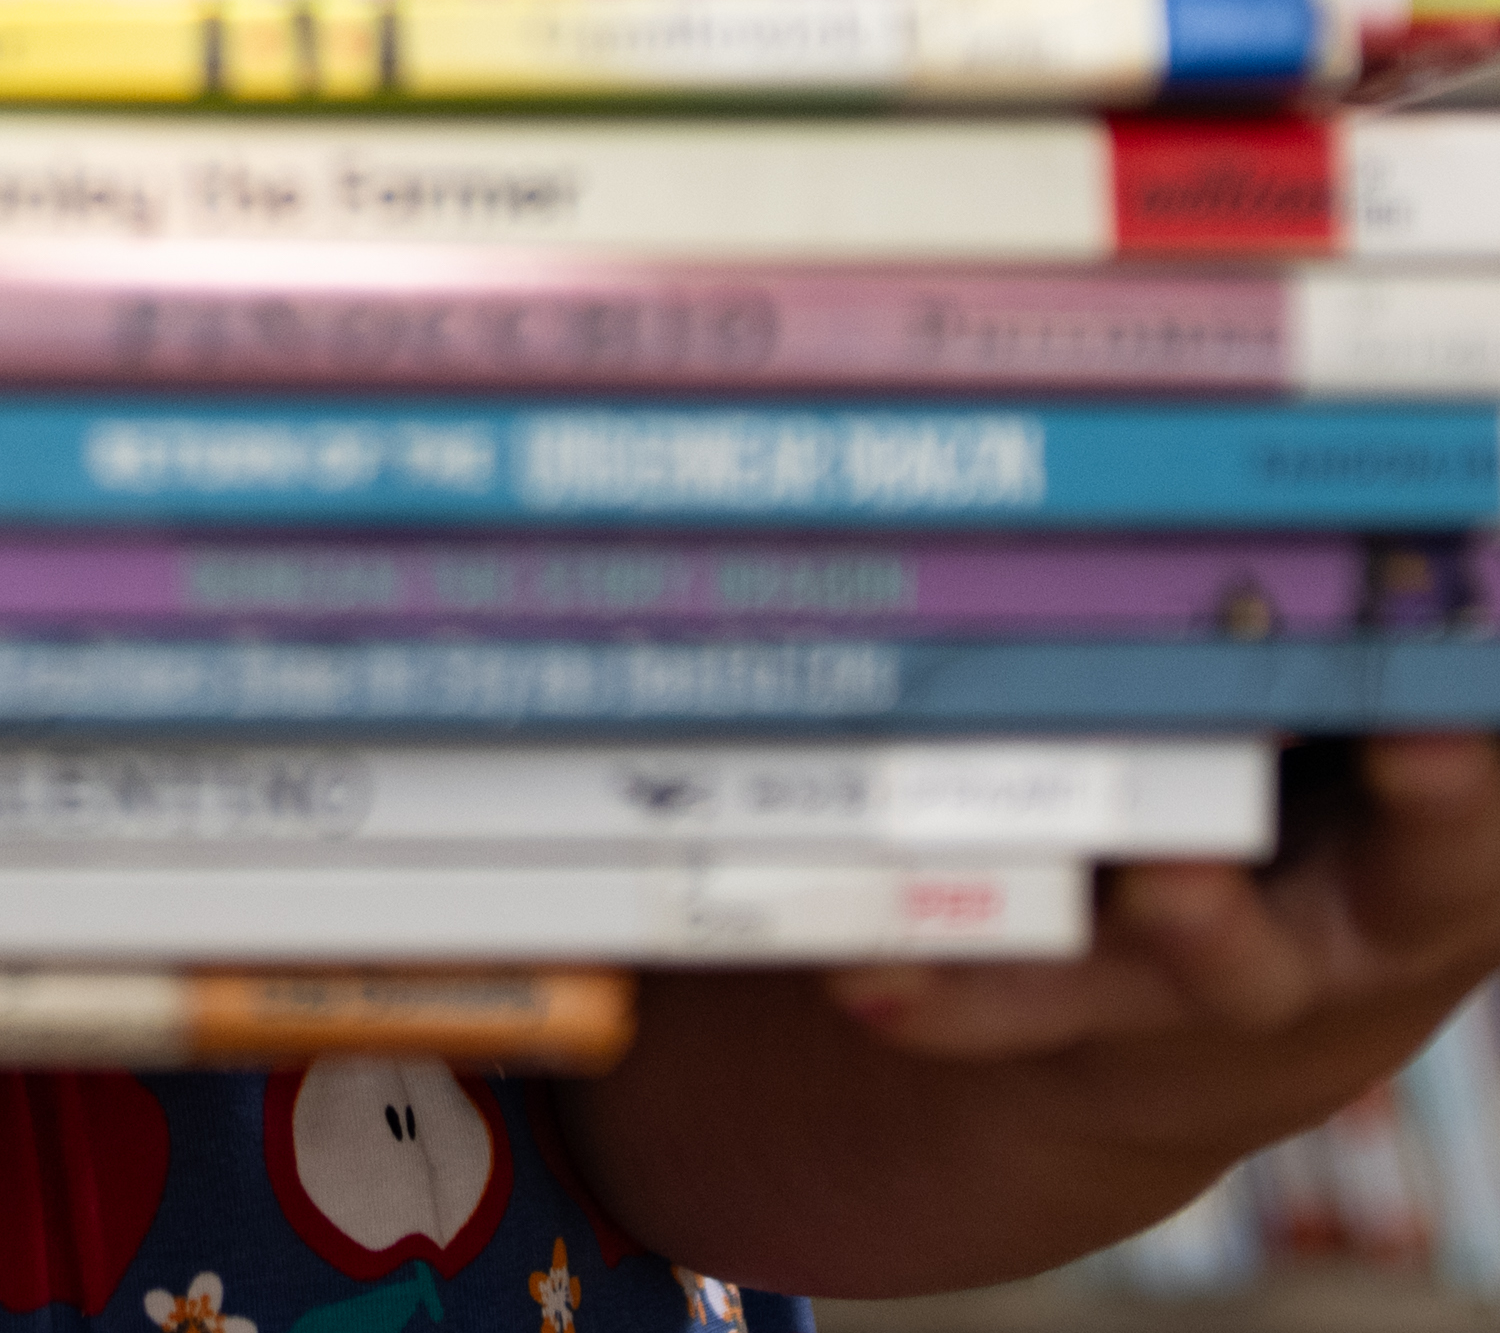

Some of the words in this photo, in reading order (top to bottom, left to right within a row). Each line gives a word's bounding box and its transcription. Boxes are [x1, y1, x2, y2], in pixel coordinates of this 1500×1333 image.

[192, 163, 308, 219] the
[333, 161, 579, 221] Farmer
[92, 429, 304, 487] RETURN
[308, 429, 380, 487] OF
[396, 429, 490, 487] THE
[517, 419, 828, 501] UNDERWEAR
[834, 417, 1040, 499] DRAGON
[709, 553, 914, 615] DRAGON
